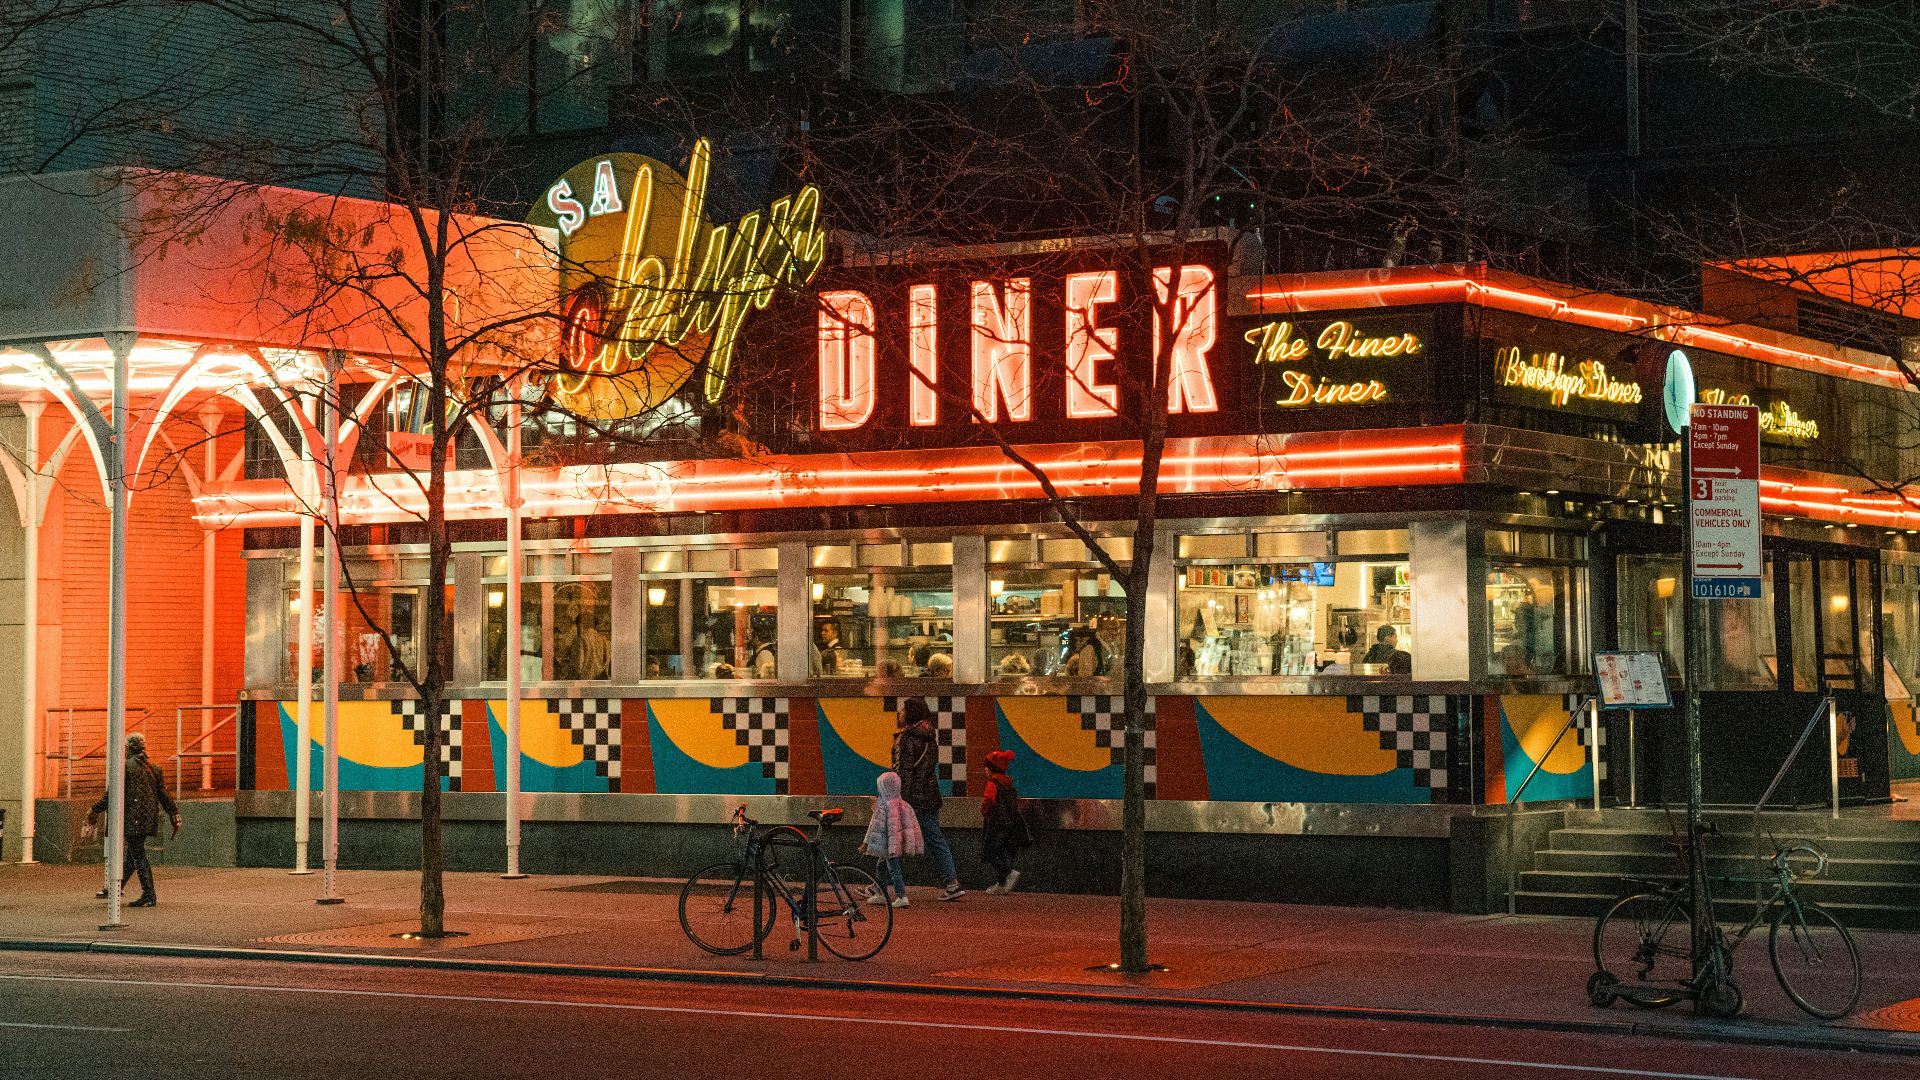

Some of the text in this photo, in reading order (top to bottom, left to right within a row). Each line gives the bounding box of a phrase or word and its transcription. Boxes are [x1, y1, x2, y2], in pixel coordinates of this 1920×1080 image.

[818, 264, 1219, 432] DINER
[1244, 321, 1419, 364] The Finer
[1502, 346, 1643, 405] Brooklyn Diner
[1276, 370, 1387, 405] Diner
[1693, 408, 1749, 420] NO STANDING
[1693, 422, 1707, 431] 7am
[1712, 423, 1729, 432] 10am
[1693, 432, 1708, 441] 4pm
[1713, 432, 1728, 442] 7pm
[1693, 441, 1739, 452] Except Sunday
[1696, 480, 1708, 499] 3
[1694, 508, 1743, 517] COMMERCIAL
[1695, 519, 1751, 528] VEHICLES ONLY
[1695, 540, 1712, 549] 10am
[1717, 541, 1731, 550] 4pm
[1695, 550, 1746, 559] Except Sunday
[1694, 584, 1736, 596] 101610
